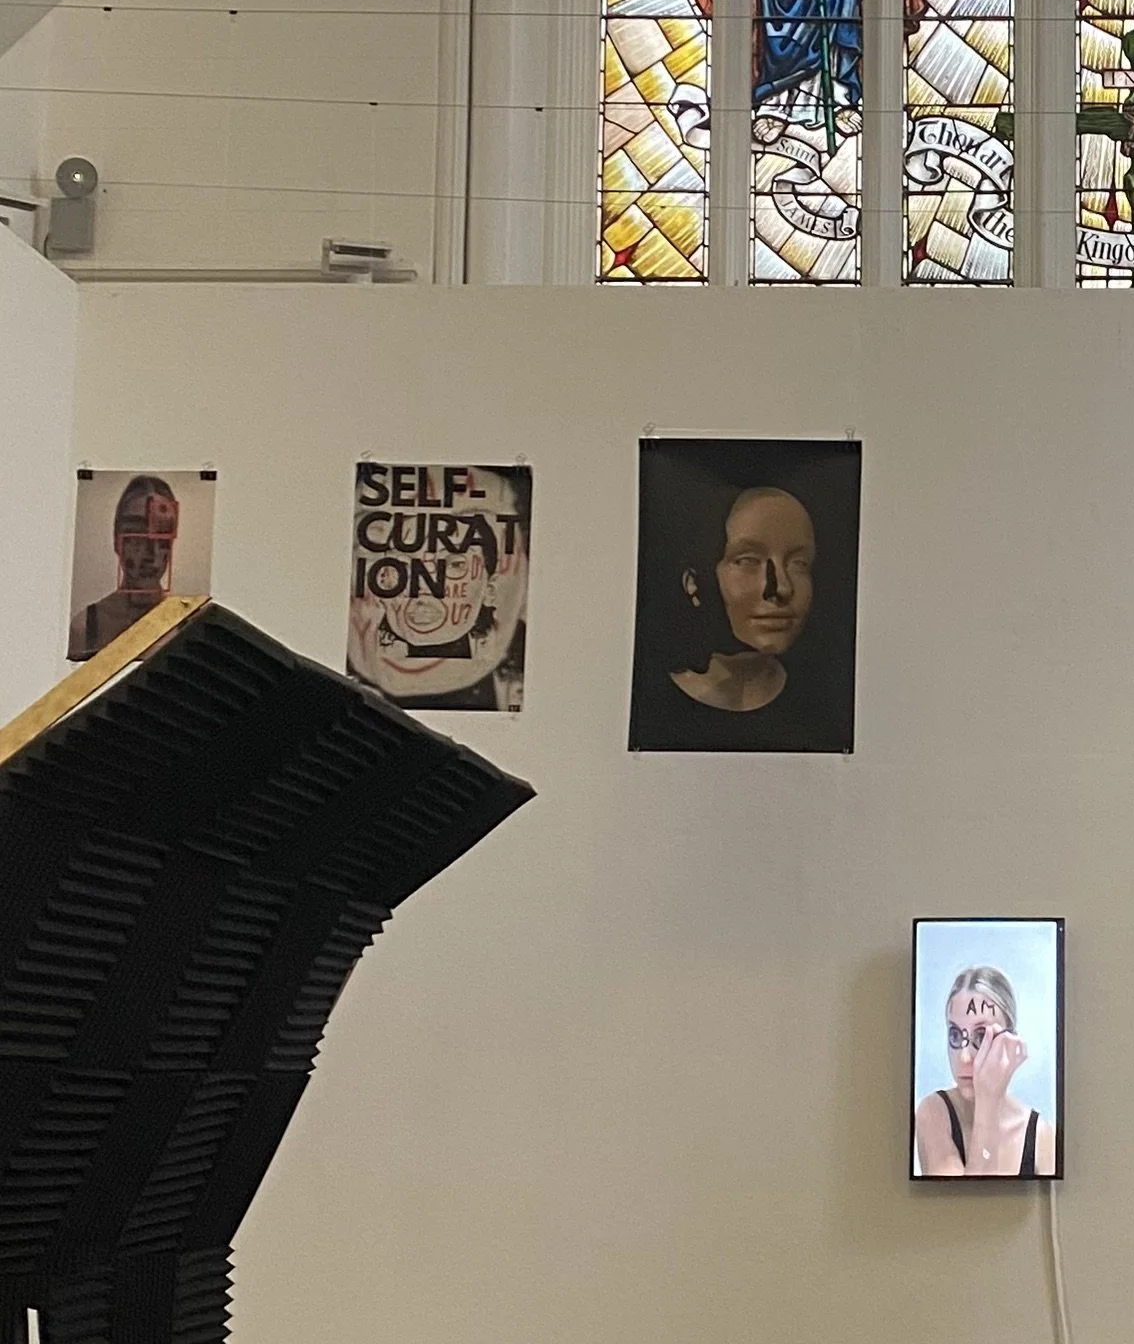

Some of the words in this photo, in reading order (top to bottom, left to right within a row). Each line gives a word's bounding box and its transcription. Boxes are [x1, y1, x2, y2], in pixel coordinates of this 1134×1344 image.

[777, 139, 816, 163] Saint
[982, 210, 1014, 243] the
[1076, 230, 1123, 265] King
[358, 467, 486, 507] SELF-
[357, 511, 525, 556] CURAT
[355, 557, 447, 598] ION
